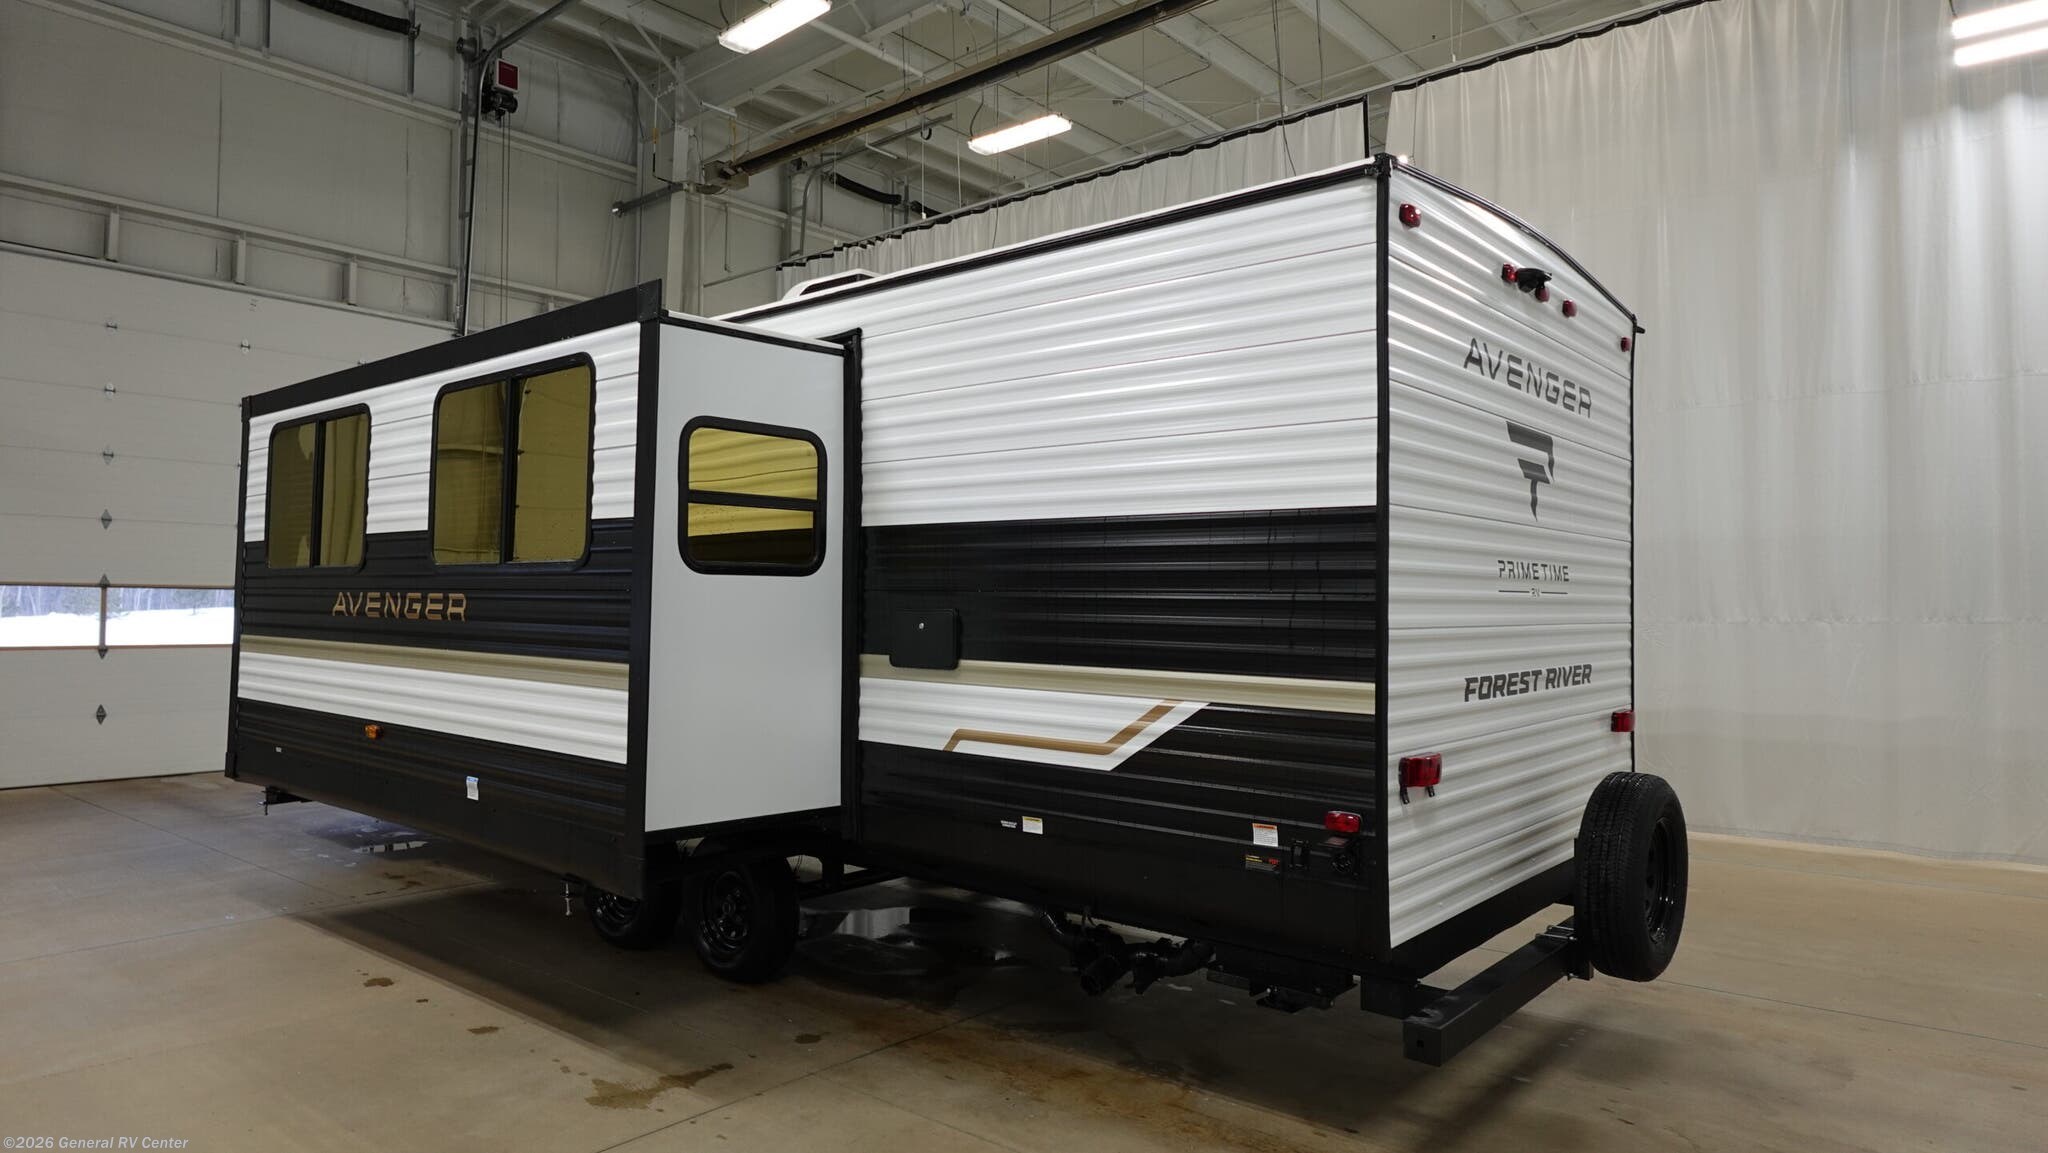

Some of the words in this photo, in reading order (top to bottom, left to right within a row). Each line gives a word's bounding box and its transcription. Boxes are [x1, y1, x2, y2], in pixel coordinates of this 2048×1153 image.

[1464, 337, 1593, 419] AVENGER
[1497, 559, 1570, 582] PRIMETIME
[332, 591, 467, 622] AVENGER
[1464, 669, 1543, 703] FOREST
[1545, 663, 1593, 691] RIVER
